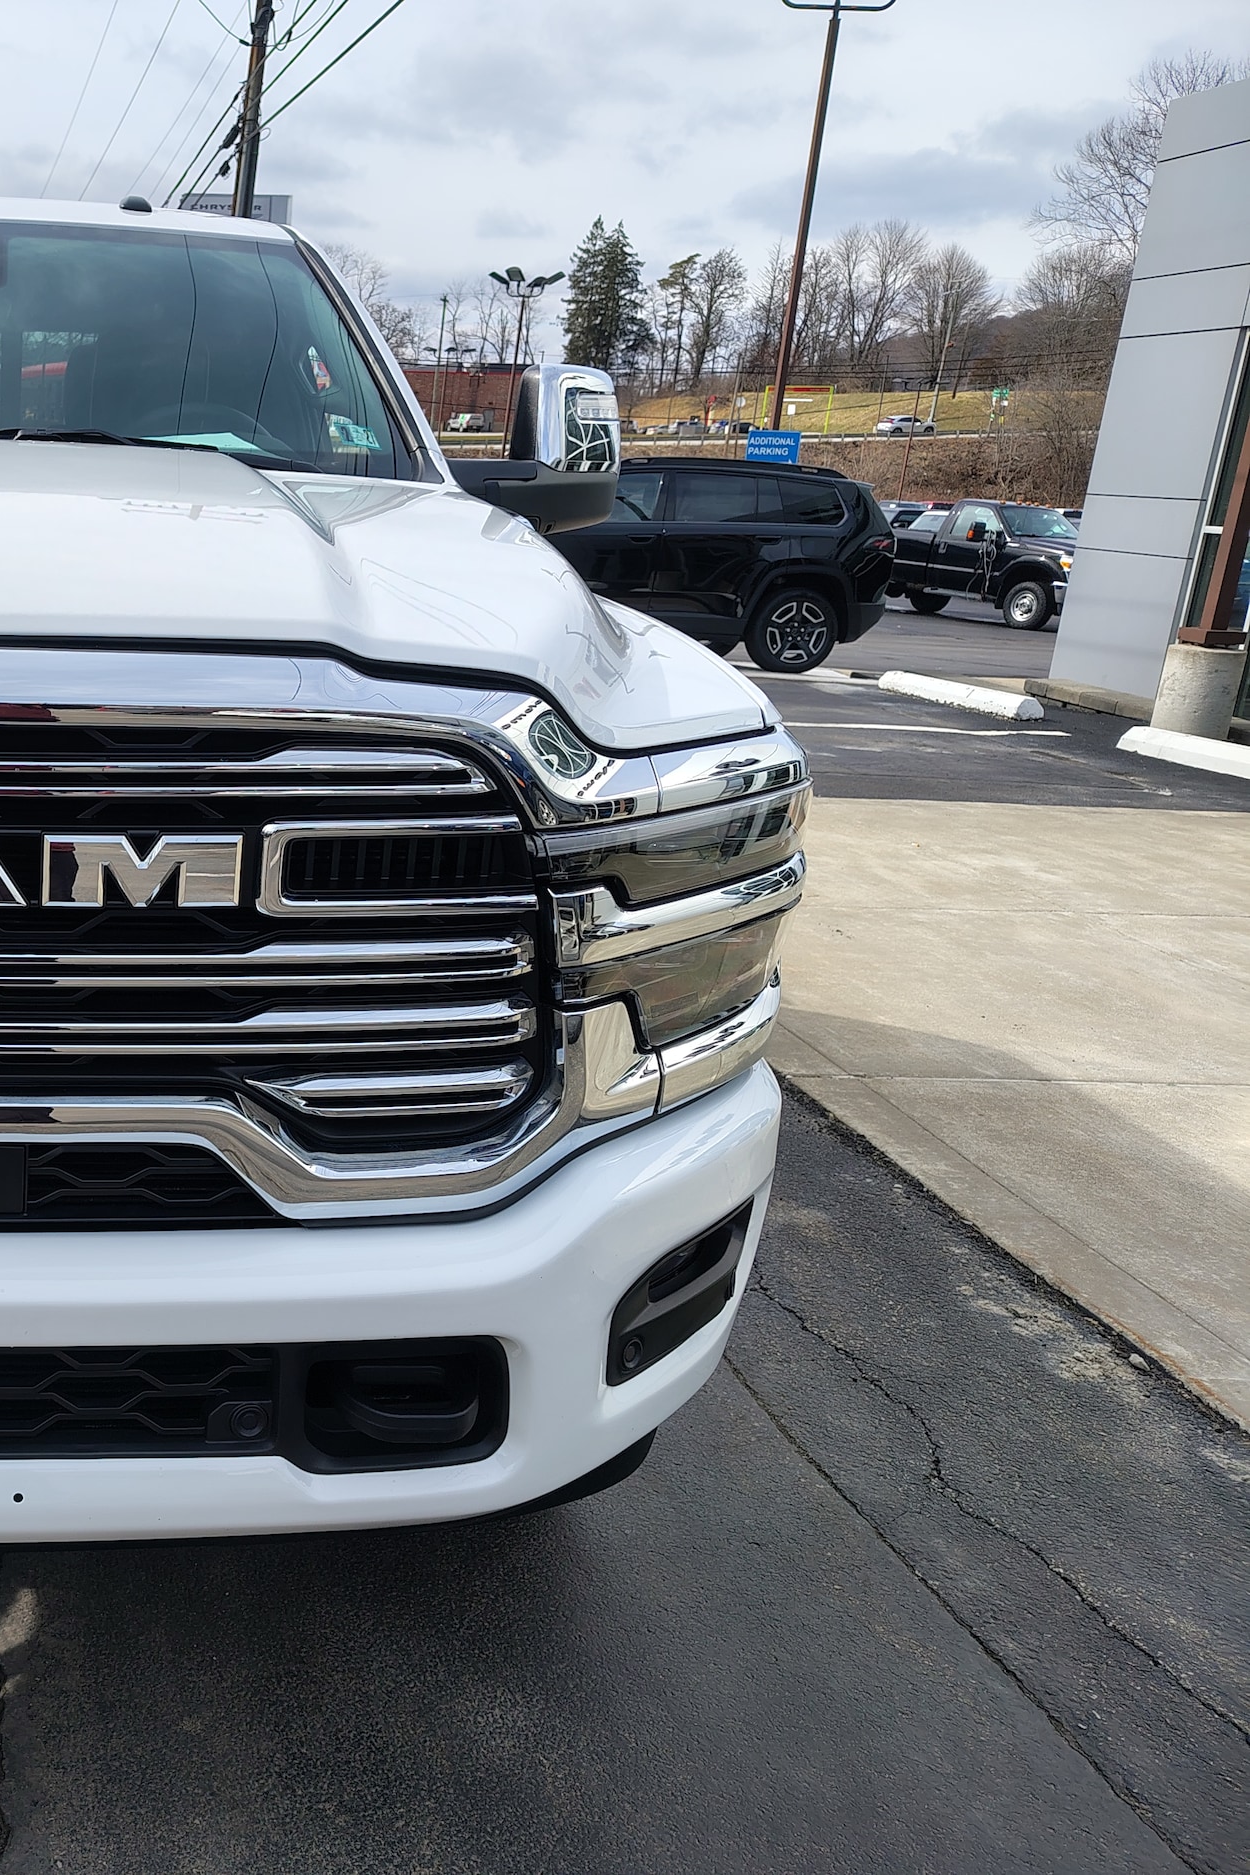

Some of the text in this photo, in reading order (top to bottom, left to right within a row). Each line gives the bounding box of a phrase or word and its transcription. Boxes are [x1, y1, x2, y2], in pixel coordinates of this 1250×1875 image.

[191, 203, 262, 211] CHRYSR
[749, 437, 796, 446] ADDITIONAL
[747, 447, 789, 456] PARKING
